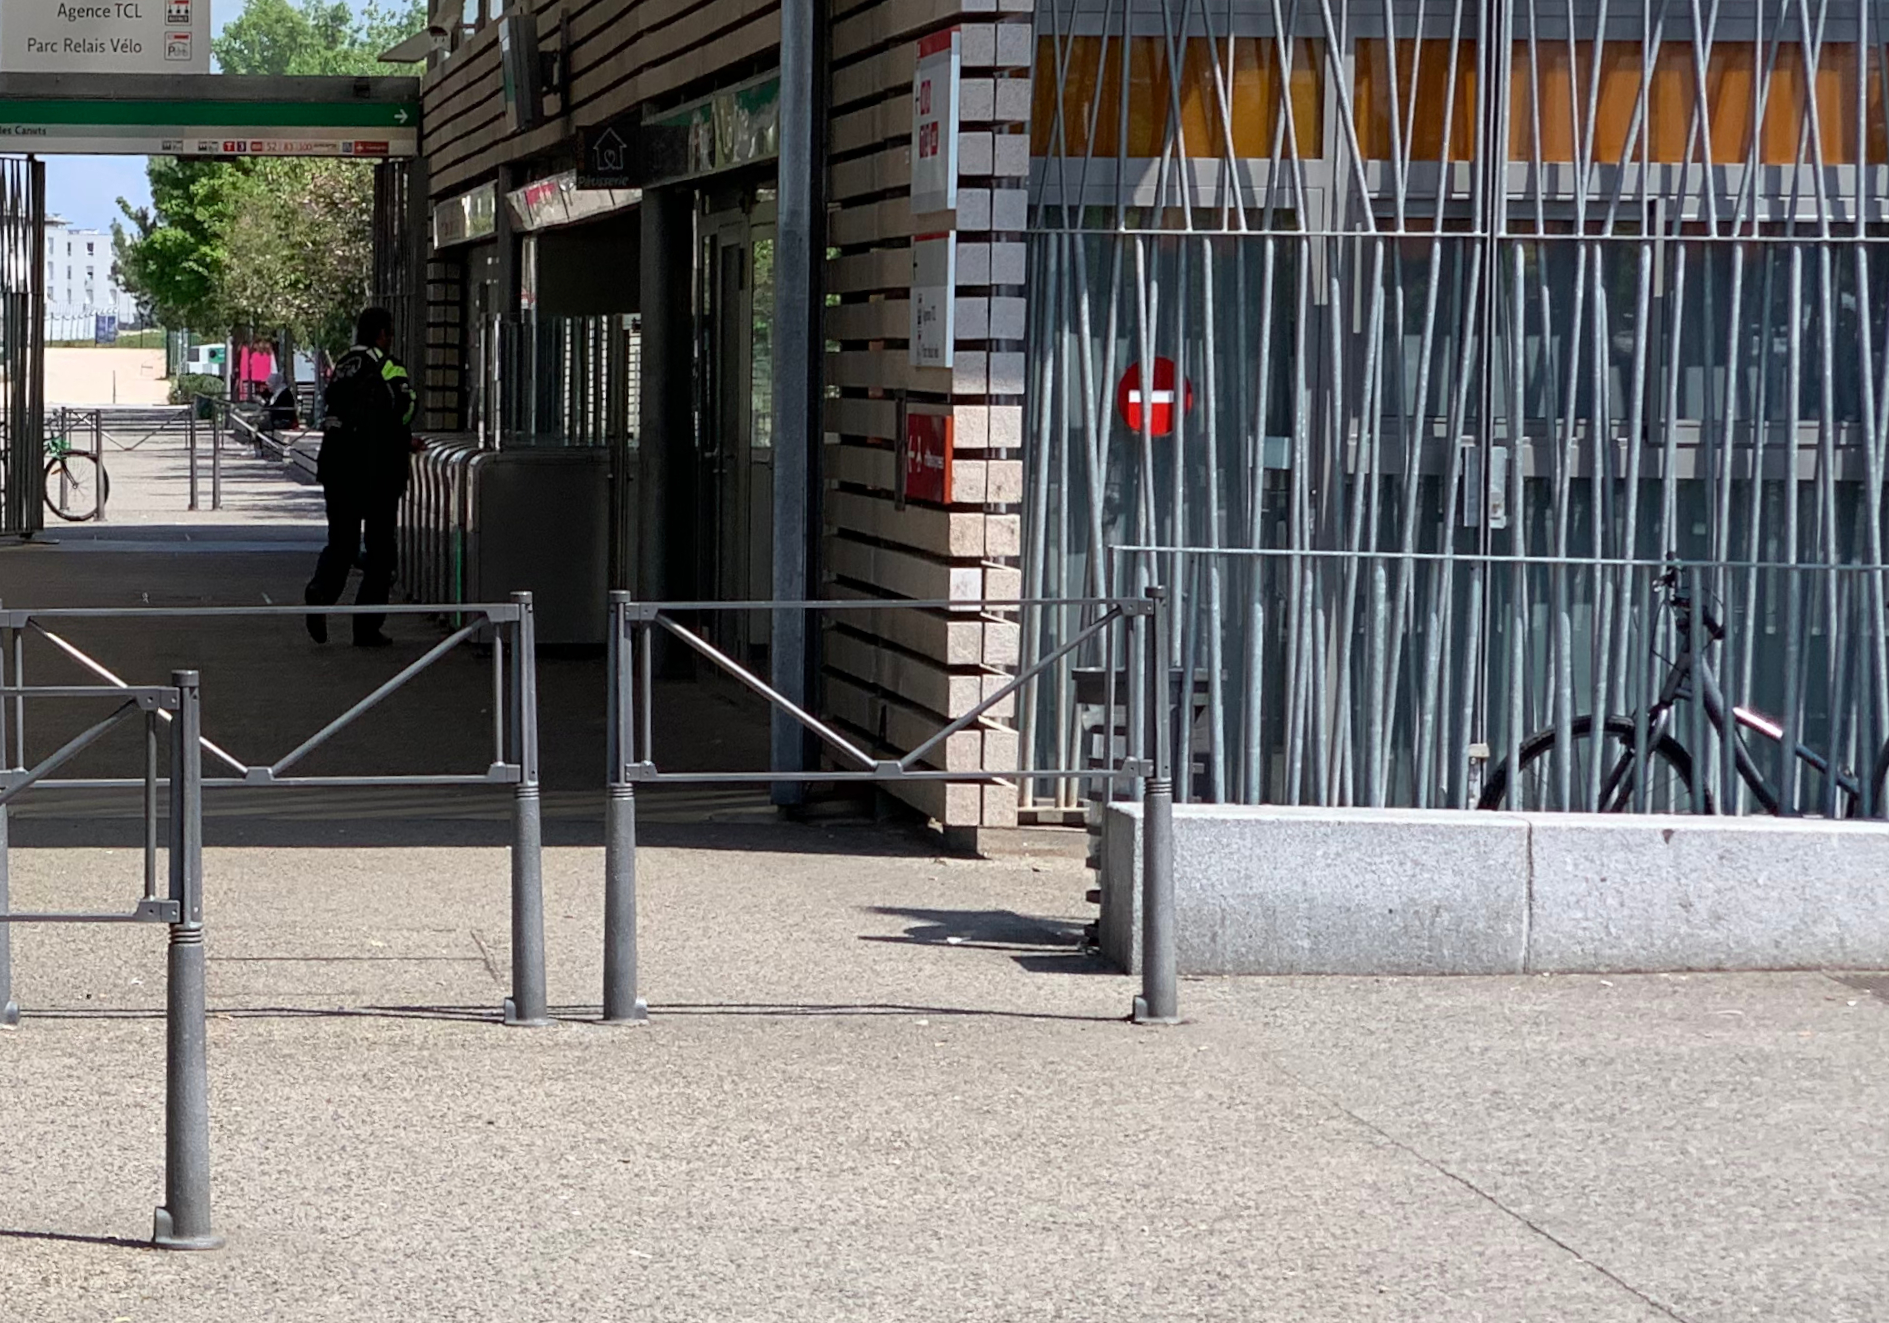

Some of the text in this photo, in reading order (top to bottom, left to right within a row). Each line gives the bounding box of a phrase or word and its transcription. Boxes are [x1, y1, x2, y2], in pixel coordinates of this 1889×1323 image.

[56, 2, 142, 22] Agence TCL
[27, 37, 143, 53] Parc Relais Vélo
[14, 125, 47, 136] Canuts
